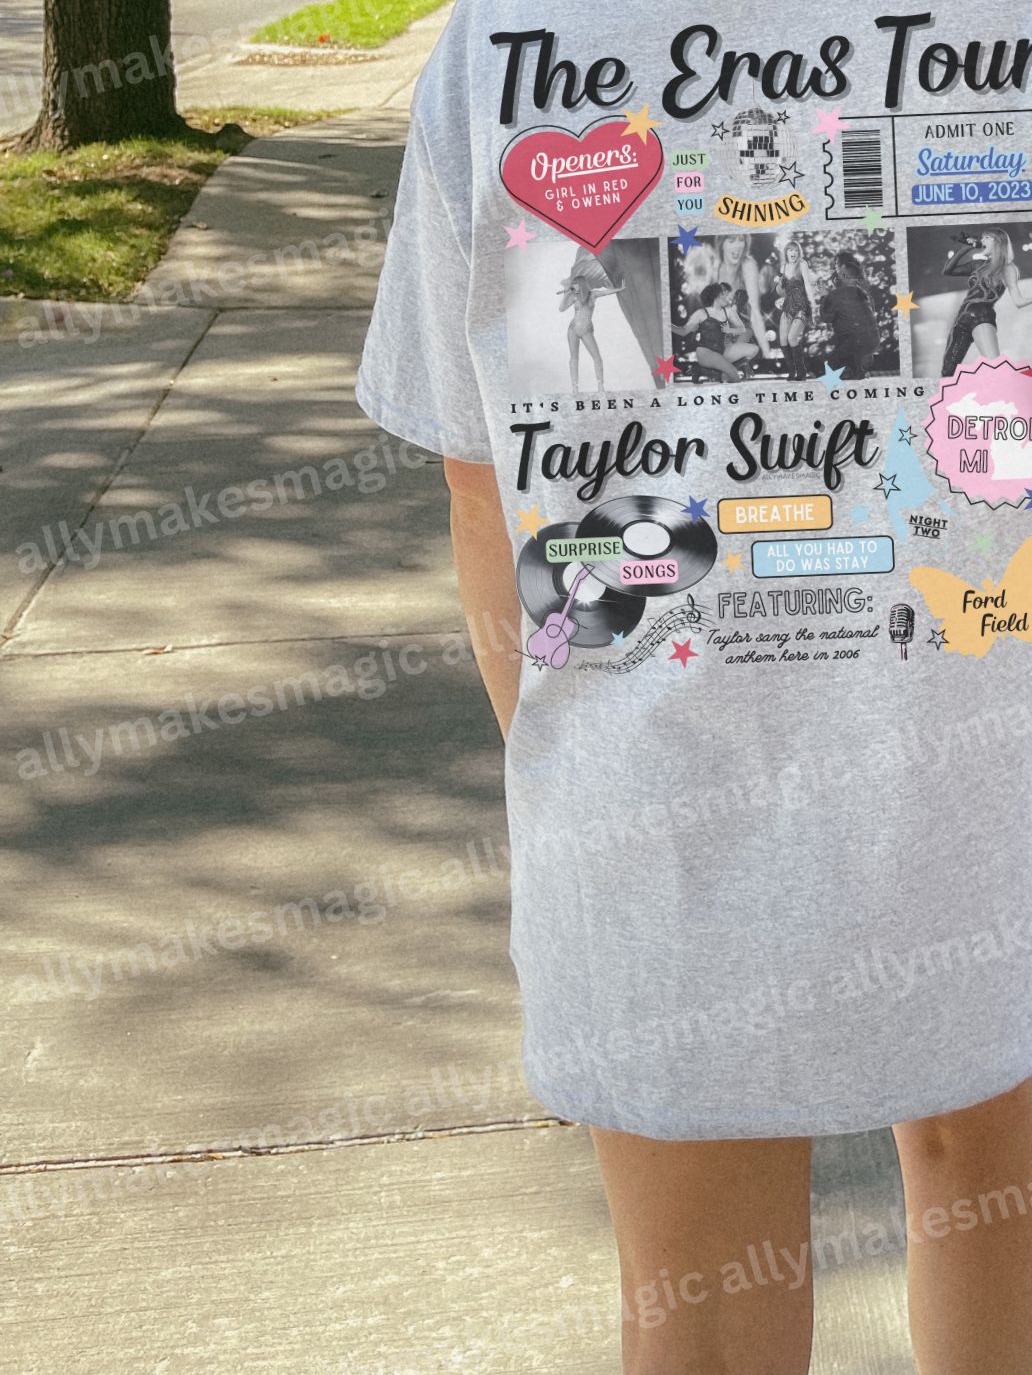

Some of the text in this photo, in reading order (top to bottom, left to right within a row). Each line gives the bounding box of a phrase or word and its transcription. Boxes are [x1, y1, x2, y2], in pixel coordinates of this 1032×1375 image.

[489, 28, 637, 127] The
[662, 24, 853, 121] Eras
[925, 121, 1015, 139] ADMIT ONE
[530, 144, 638, 184] Openers:
[672, 153, 706, 166] JUST
[545, 179, 628, 200] GIRL IN RED
[676, 176, 702, 188] FOR
[914, 181, 1031, 203] JUNE 10, 2023
[556, 192, 621, 213] & OWENN
[677, 198, 703, 211] YOU
[718, 194, 806, 222] SHINING
[575, 398, 635, 411] BEEN
[650, 397, 662, 409] A
[677, 394, 740, 407] LONG
[756, 391, 815, 403] TIME
[830, 386, 925, 400] COMING
[509, 412, 882, 503] Taylor Swift
[959, 449, 988, 474] MI
[735, 503, 815, 523] BREATHE
[909, 514, 949, 529] NIGHT
[913, 525, 941, 538] TWO
[548, 542, 622, 558] SURPRISE
[767, 539, 878, 557] ALL YOU HAD TO
[622, 564, 676, 580] SONGS
[776, 555, 869, 573] DO WAS STAY
[718, 587, 875, 619] FEATURING:
[962, 589, 1008, 613] Ford
[981, 612, 1030, 637] Field
[706, 625, 881, 651] Taylor sang the national
[725, 646, 860, 664] anthem here in 2006
